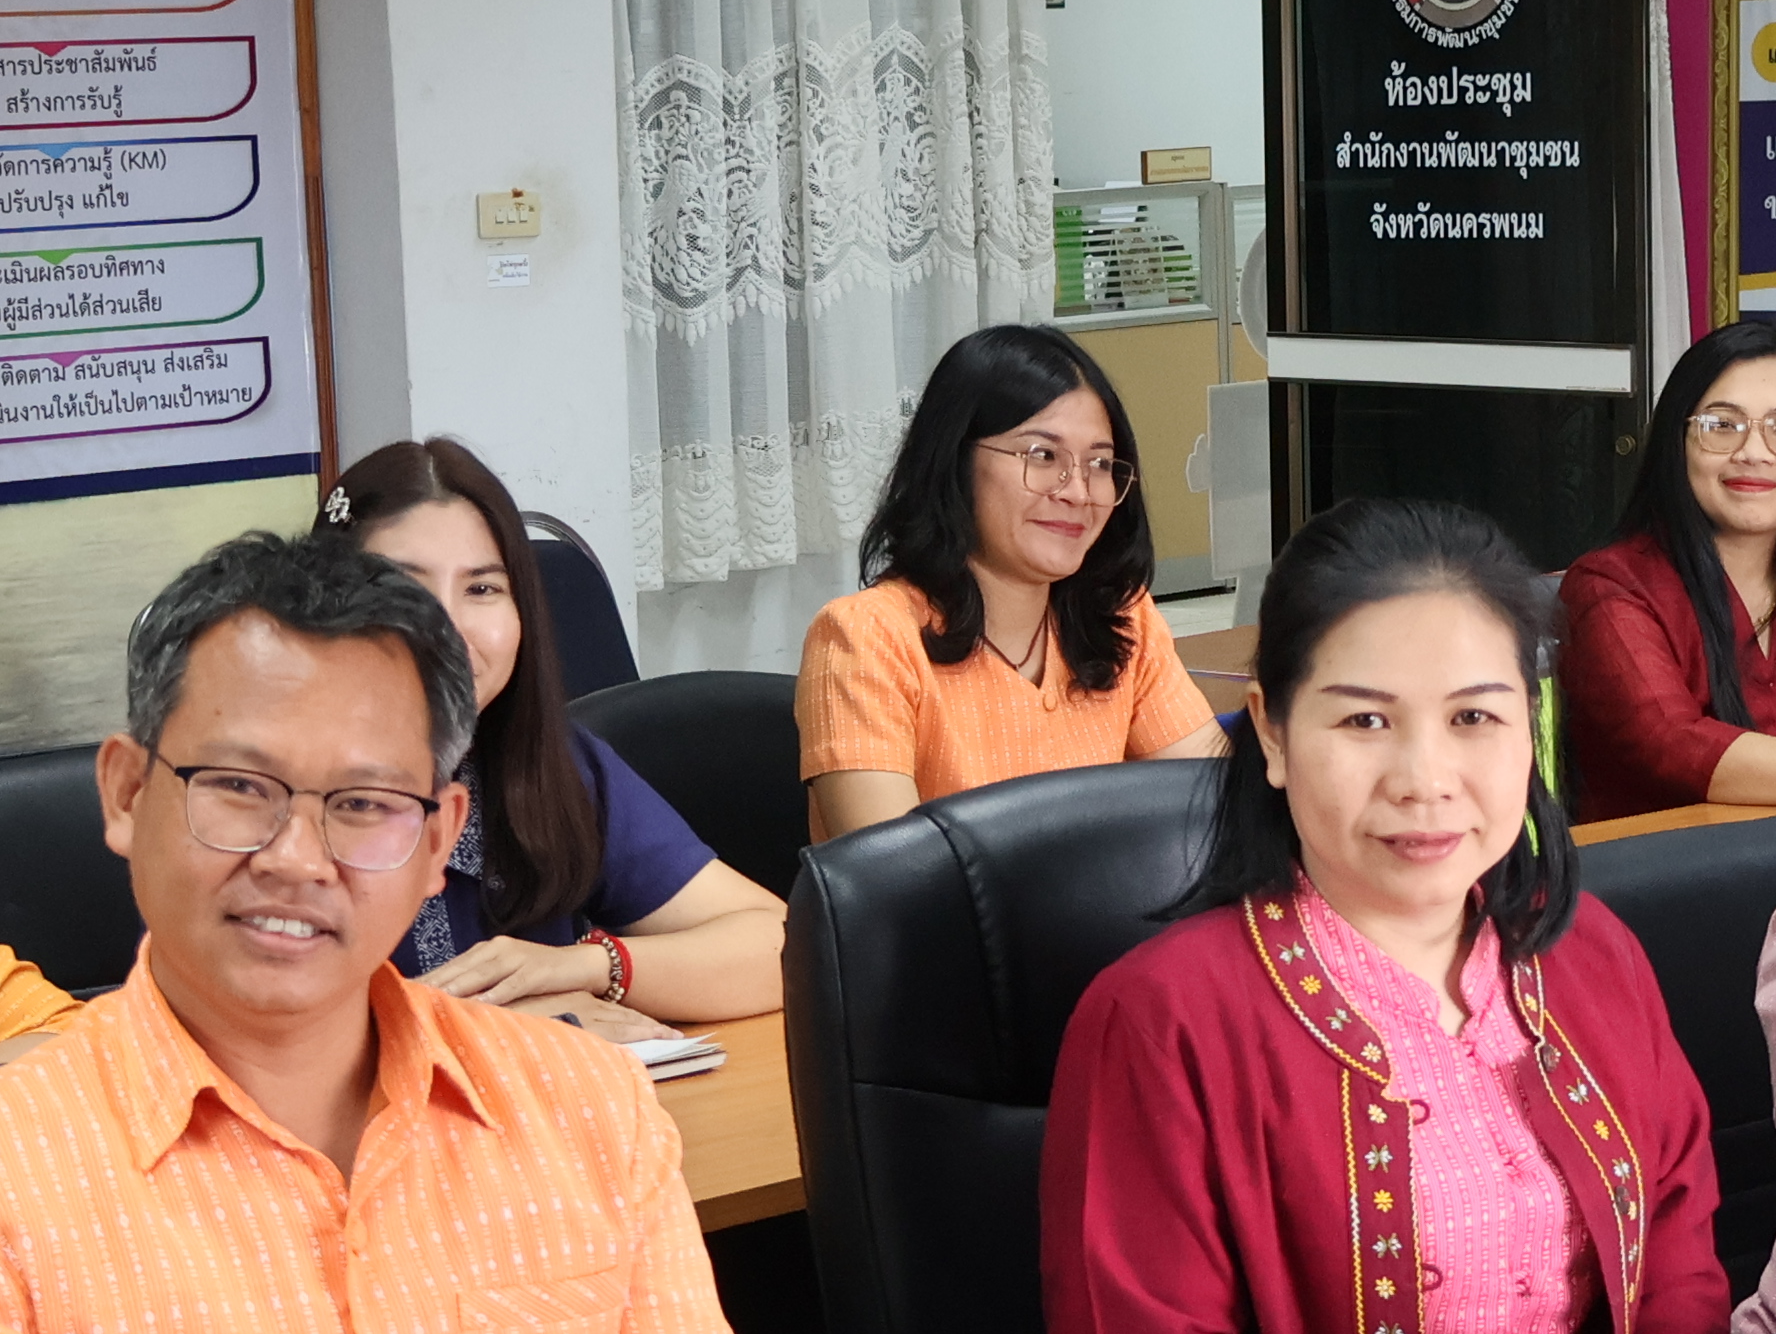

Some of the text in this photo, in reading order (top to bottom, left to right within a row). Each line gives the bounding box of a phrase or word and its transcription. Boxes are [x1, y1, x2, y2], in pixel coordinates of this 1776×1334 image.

[1384, 61, 1533, 117] ห้องประชุม
[119, 148, 168, 175] (KM)
[1336, 131, 1581, 180] สำนักงานพัฒนาชุมชน
[82, 183, 131, 214] แก้ไข
[1369, 202, 1545, 241] จังหวัดนครพนม
[1, 358, 66, 390] ติดตาม
